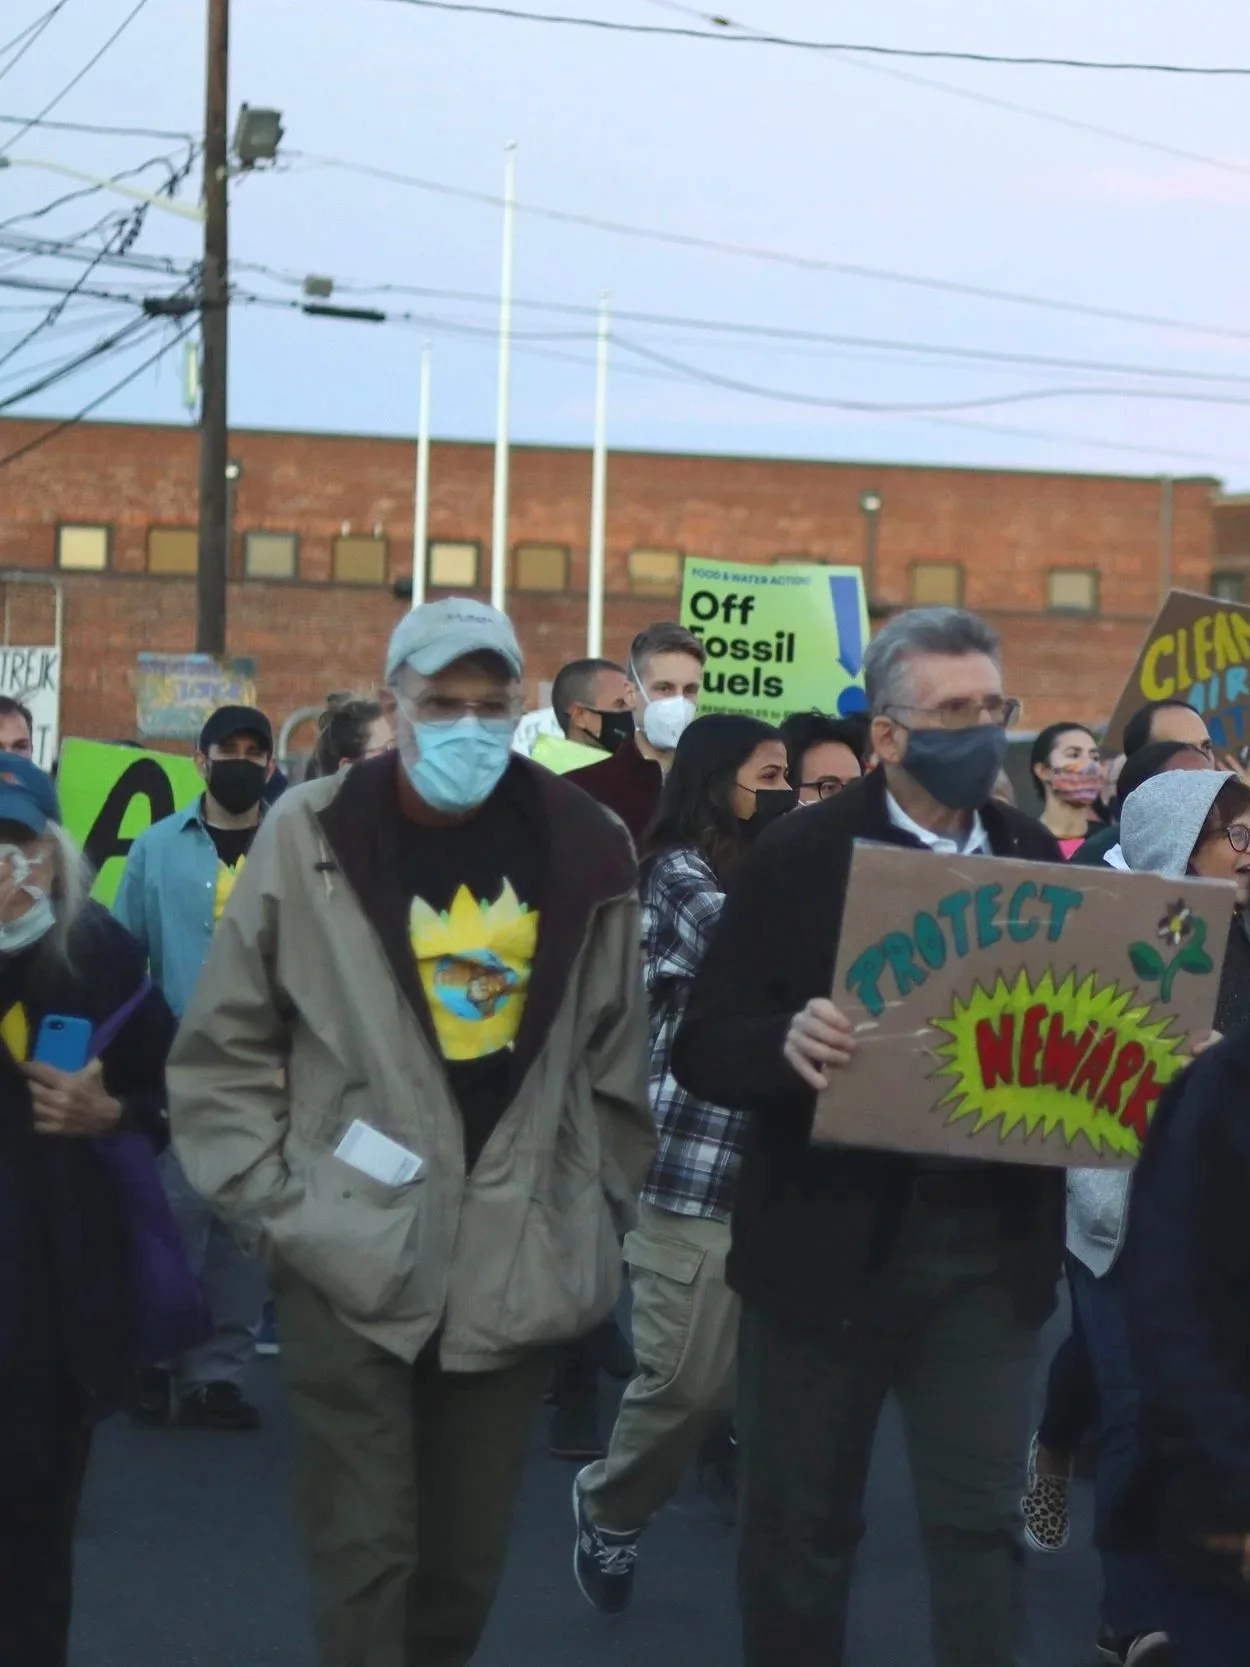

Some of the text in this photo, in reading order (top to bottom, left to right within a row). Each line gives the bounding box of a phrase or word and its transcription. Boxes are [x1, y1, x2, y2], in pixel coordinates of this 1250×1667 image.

[691, 567, 720, 580] FOOD
[723, 571, 730, 581] &
[732, 573, 769, 584] WATER
[690, 590, 755, 625] Off
[703, 668, 783, 697] uels
[1188, 666, 1249, 716] AIR
[846, 881, 1083, 1017] PROTECT
[974, 1003, 1167, 1142] NEWARK
